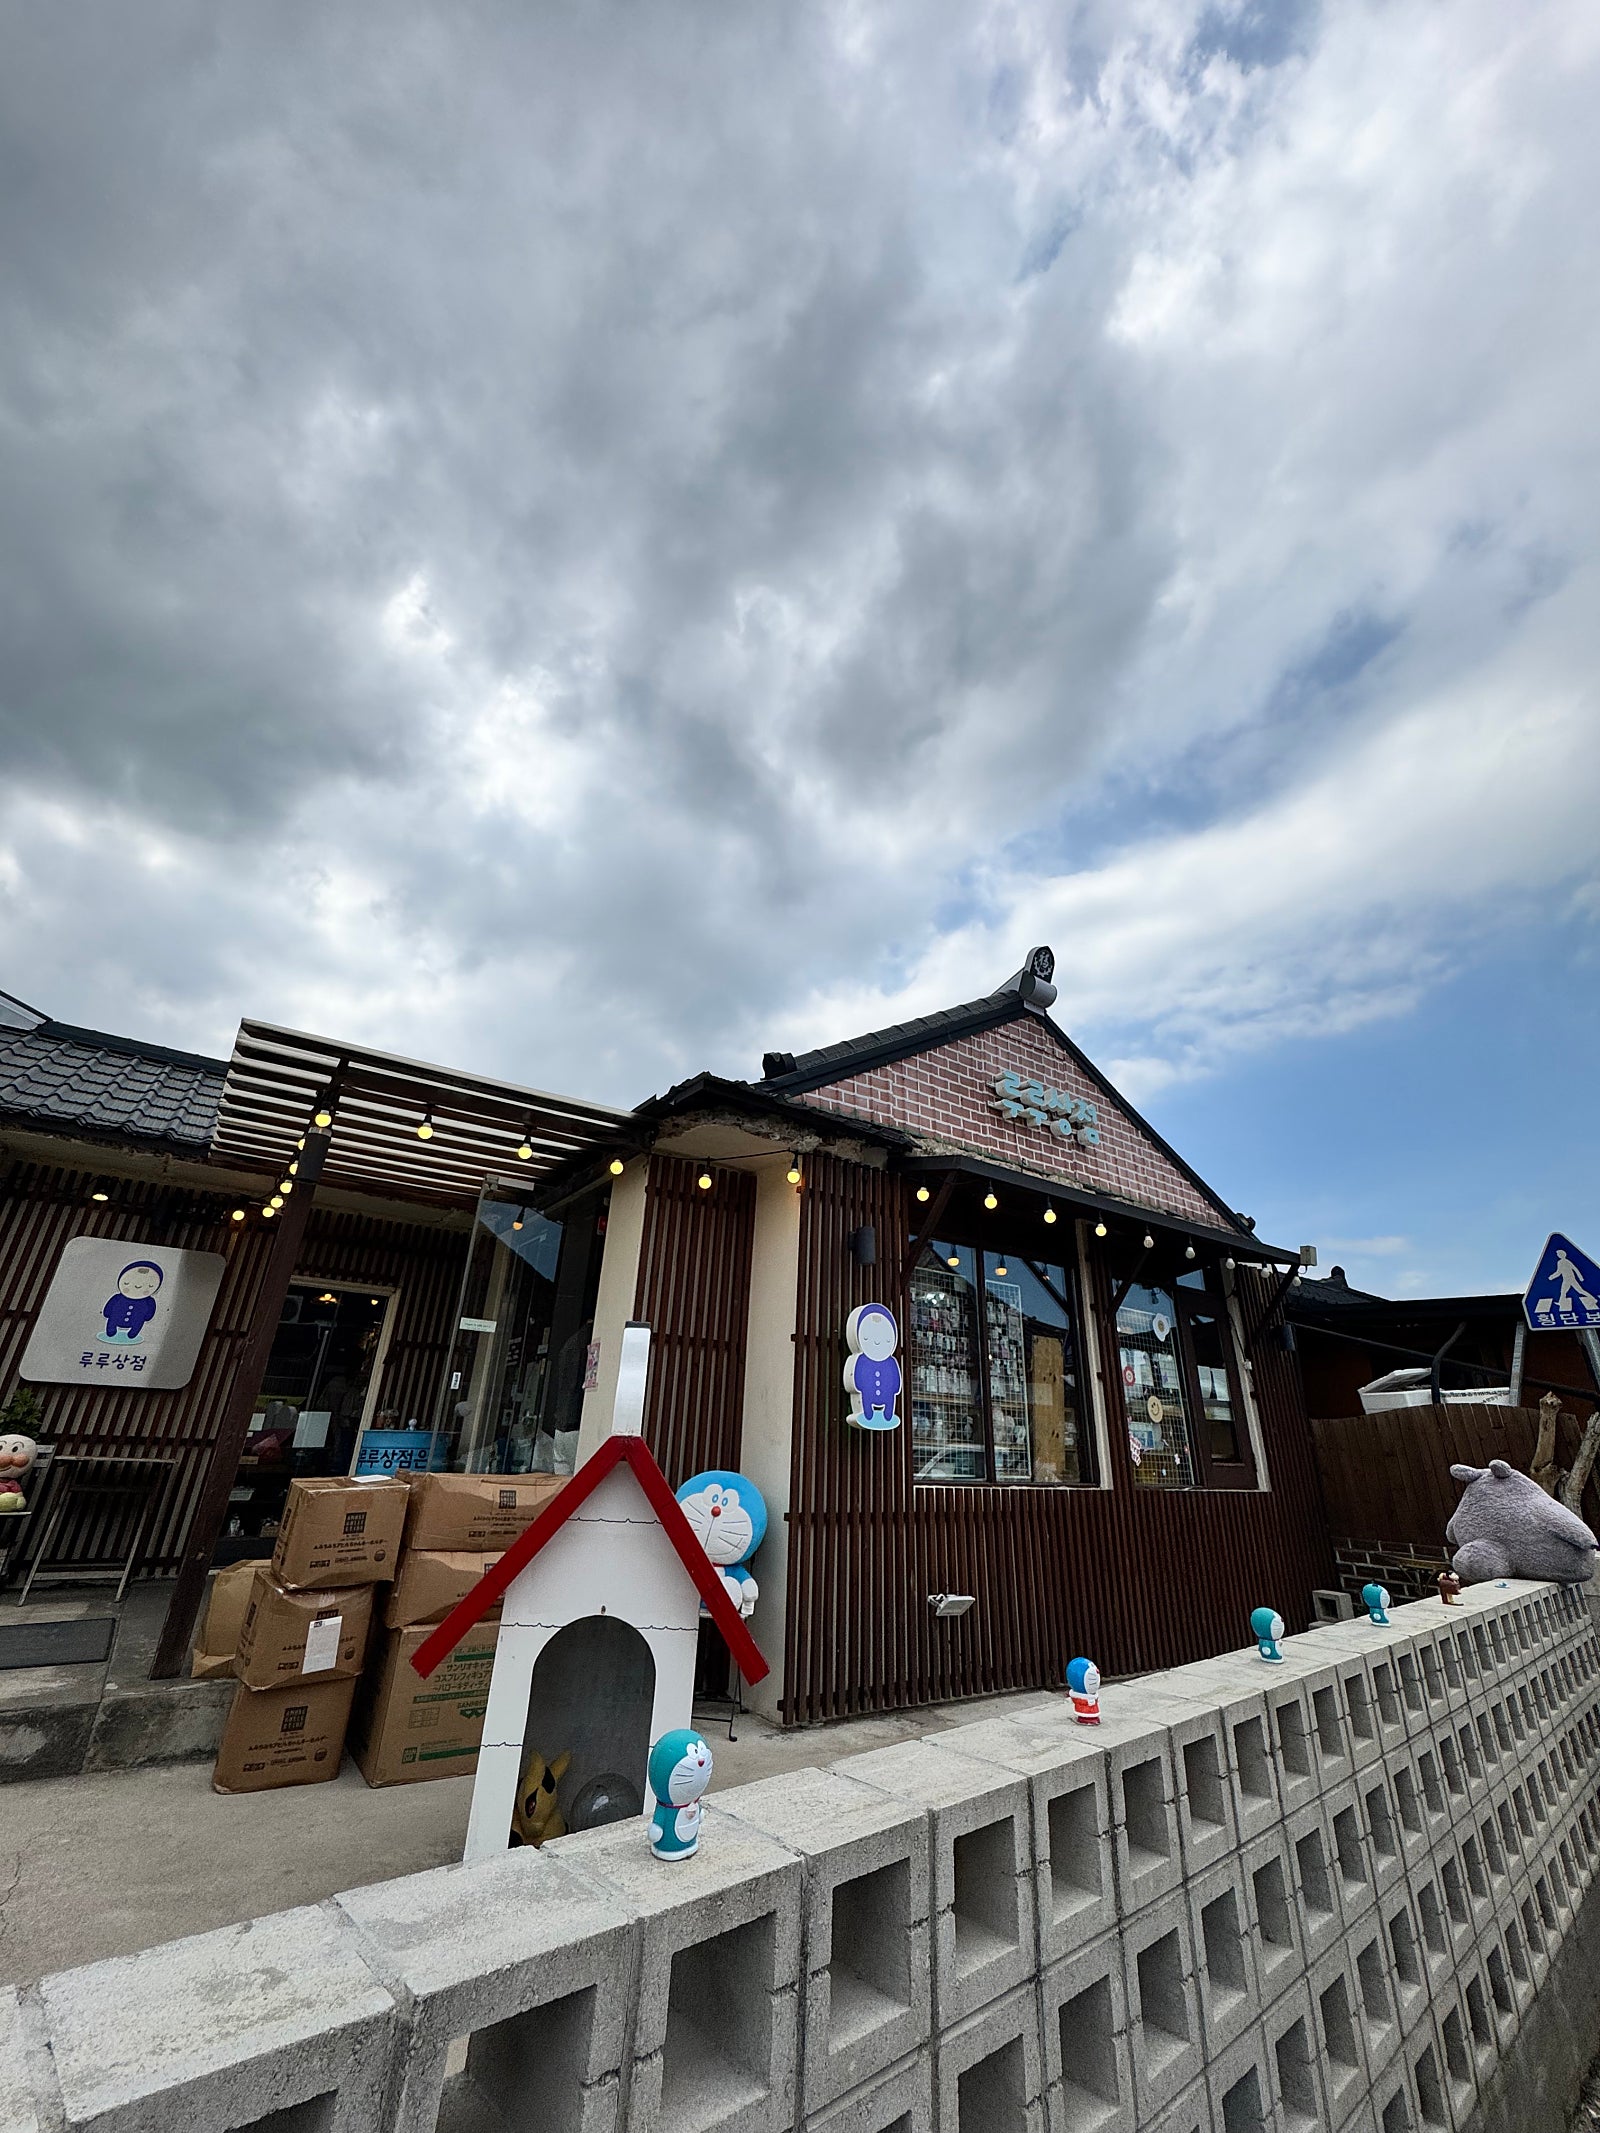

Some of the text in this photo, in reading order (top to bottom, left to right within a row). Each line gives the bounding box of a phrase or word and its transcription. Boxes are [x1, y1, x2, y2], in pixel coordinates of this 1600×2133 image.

[997, 1070, 1099, 1146] 루루상점
[1536, 1312, 1600, 1326] 횡단보
[79, 1351, 147, 1371] 루루상점
[358, 1449, 428, 1469] 루루상점은
